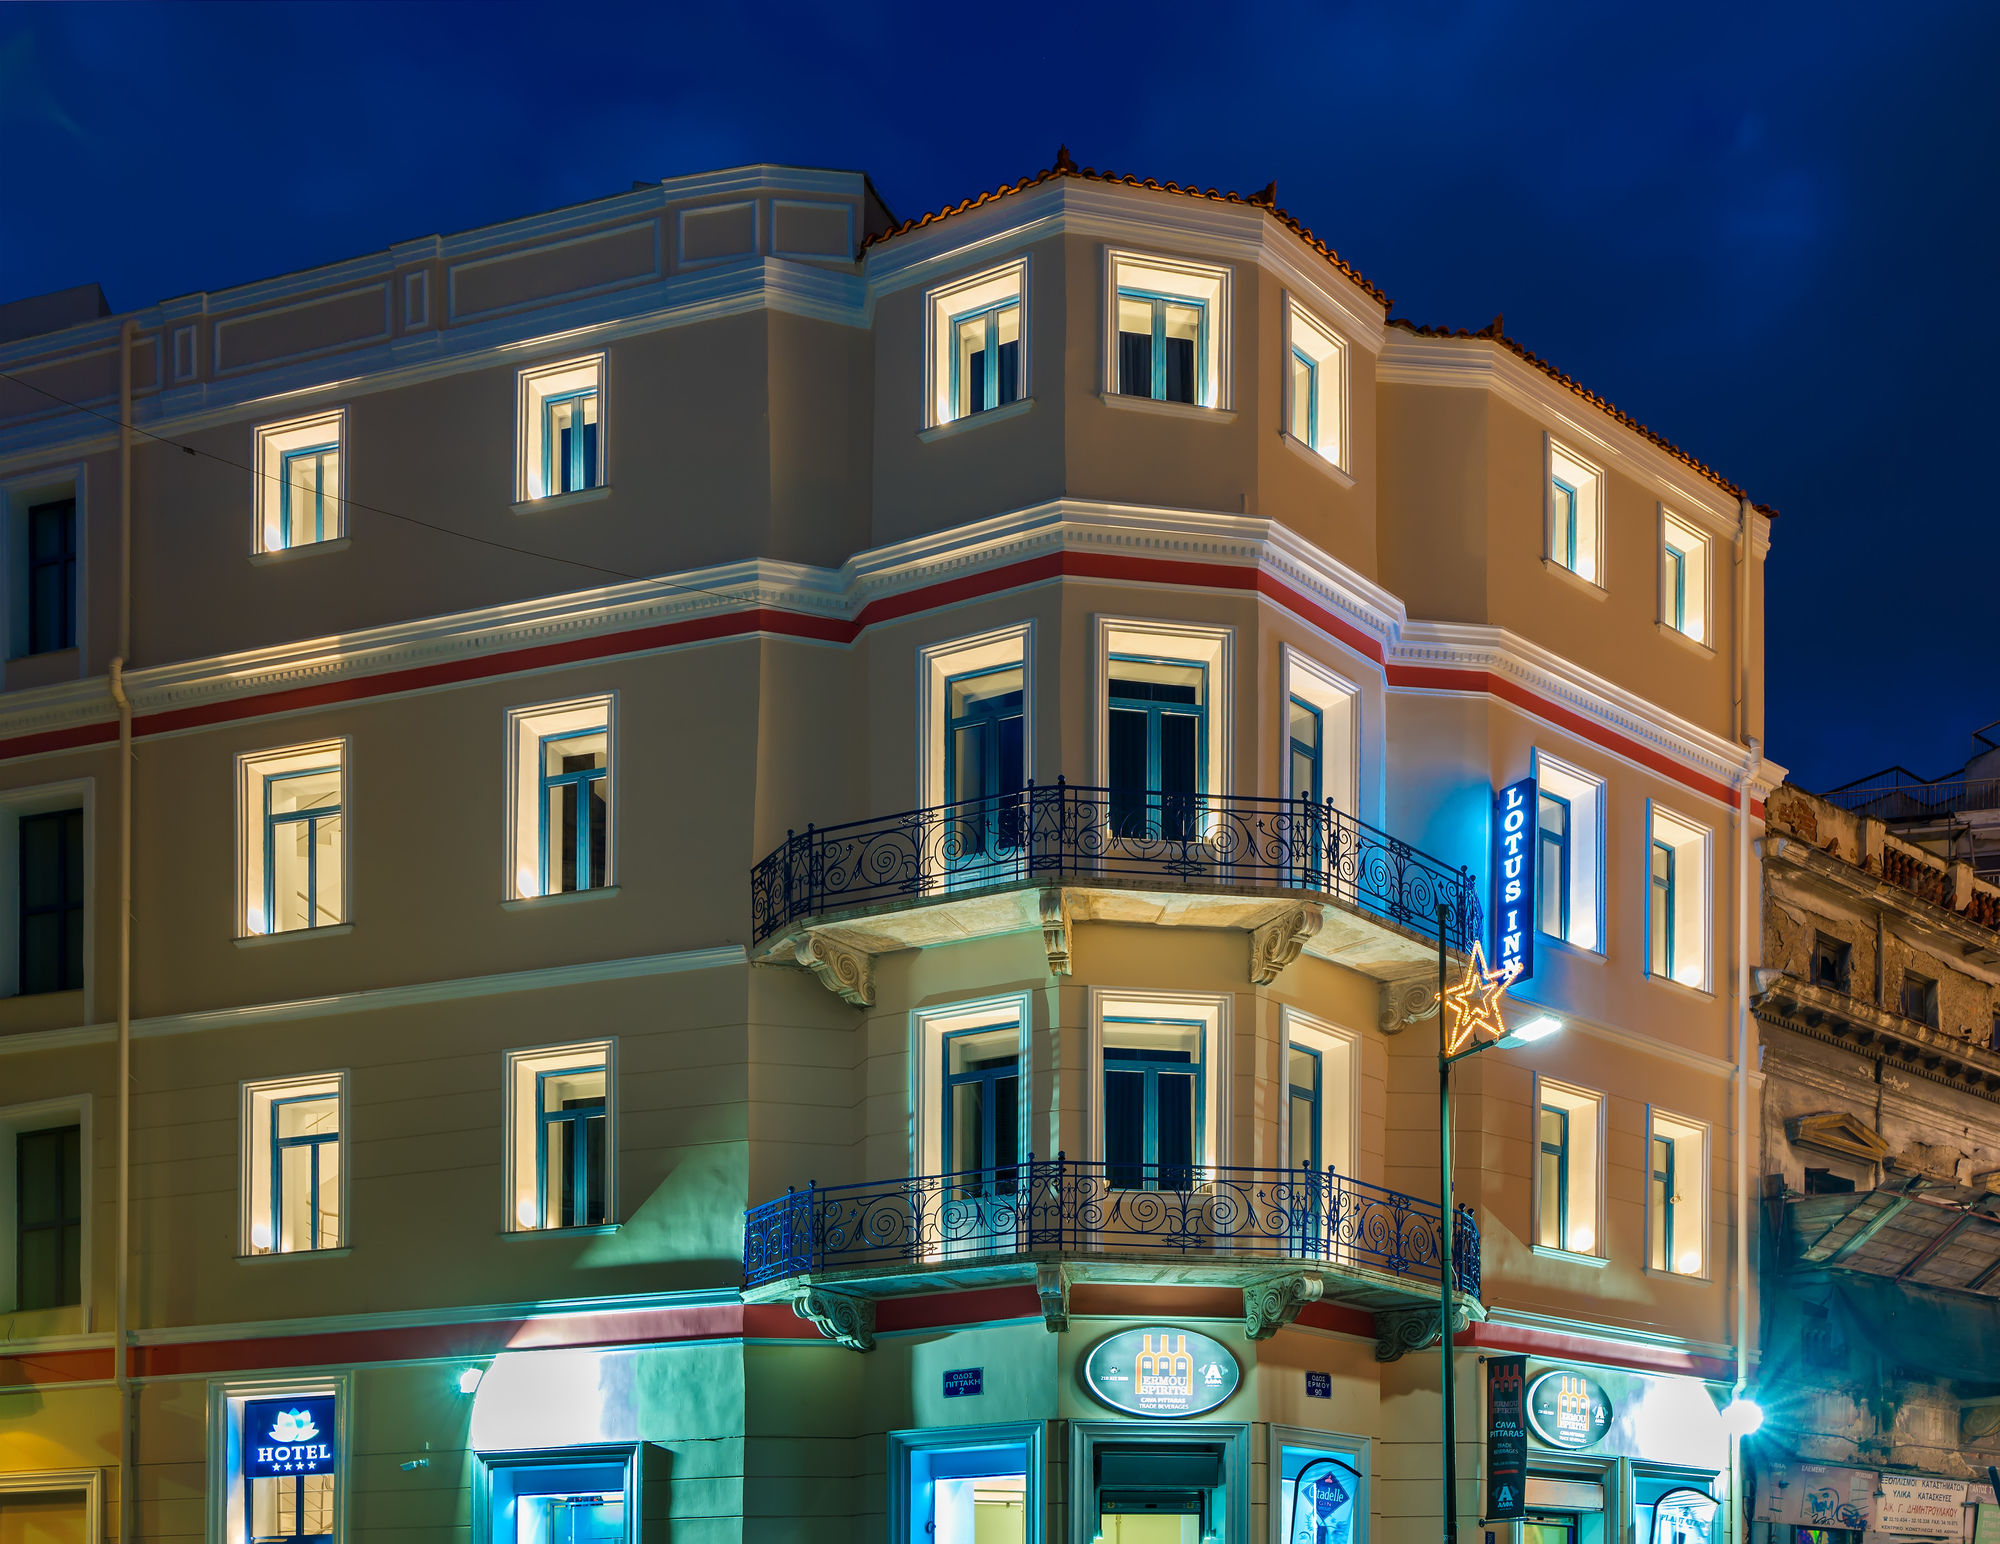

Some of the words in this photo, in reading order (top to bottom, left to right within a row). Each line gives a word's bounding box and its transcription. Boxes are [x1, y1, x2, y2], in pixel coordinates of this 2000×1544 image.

[1504, 787, 1524, 903] LOTUS
[1502, 910, 1522, 980] INN
[952, 1372, 973, 1380] ΟΔΟΣ
[1311, 1375, 1325, 1383] ΟΔΟΣ
[945, 1379, 981, 1388] ΠΙΤΤΑΚΗ
[1142, 1376, 1187, 1386] ERMOU
[1307, 1381, 1330, 1389] ΕΡΜΟΥ
[959, 1387, 965, 1395] 2
[1141, 1386, 1188, 1395] SPIRITS
[1495, 1421, 1517, 1429] CAVA
[1489, 1430, 1524, 1438] PITTARAS
[257, 1444, 331, 1462] HOTEL
[1308, 1485, 1344, 1502] Ctadelle
[1893, 1490, 1911, 1498] ΥΛΙΚΑ
